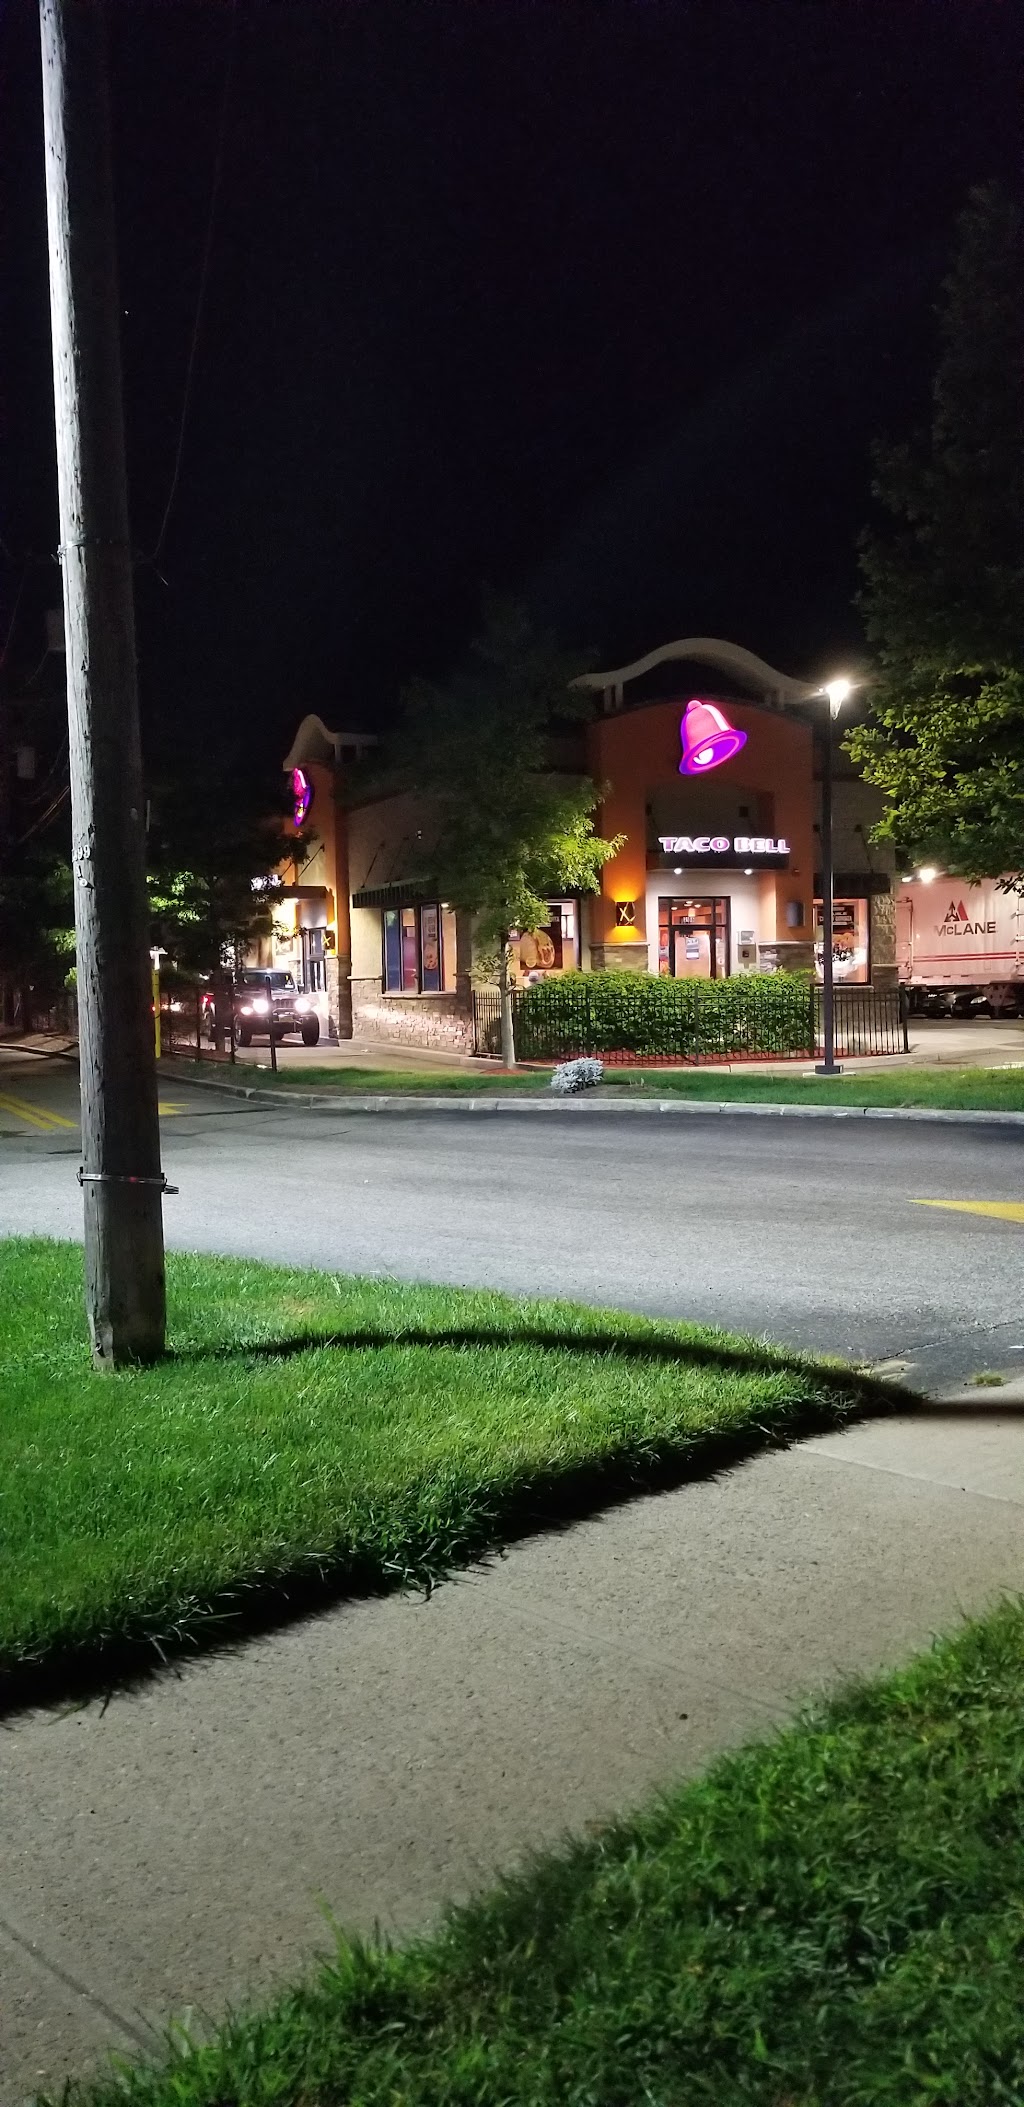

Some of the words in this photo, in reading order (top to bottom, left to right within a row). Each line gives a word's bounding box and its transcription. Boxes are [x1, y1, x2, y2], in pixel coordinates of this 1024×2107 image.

[658, 836, 730, 853] TACO
[734, 837, 790, 854] BELL
[934, 921, 997, 937] McLANE
